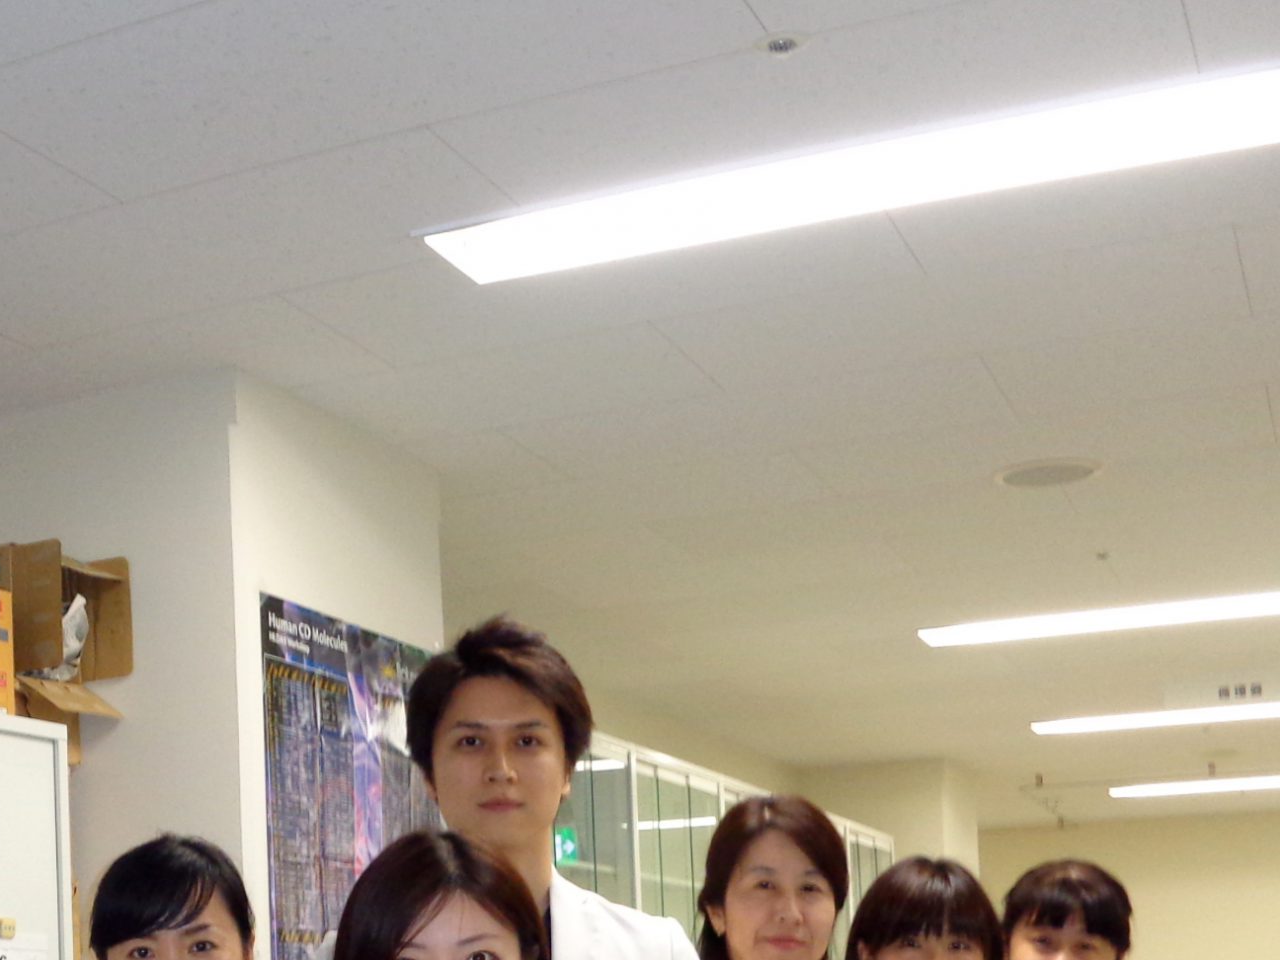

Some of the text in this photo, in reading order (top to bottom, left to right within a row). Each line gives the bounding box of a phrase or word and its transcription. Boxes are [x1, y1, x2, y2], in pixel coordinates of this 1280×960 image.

[268, 611, 349, 654] Human CD Molecules
